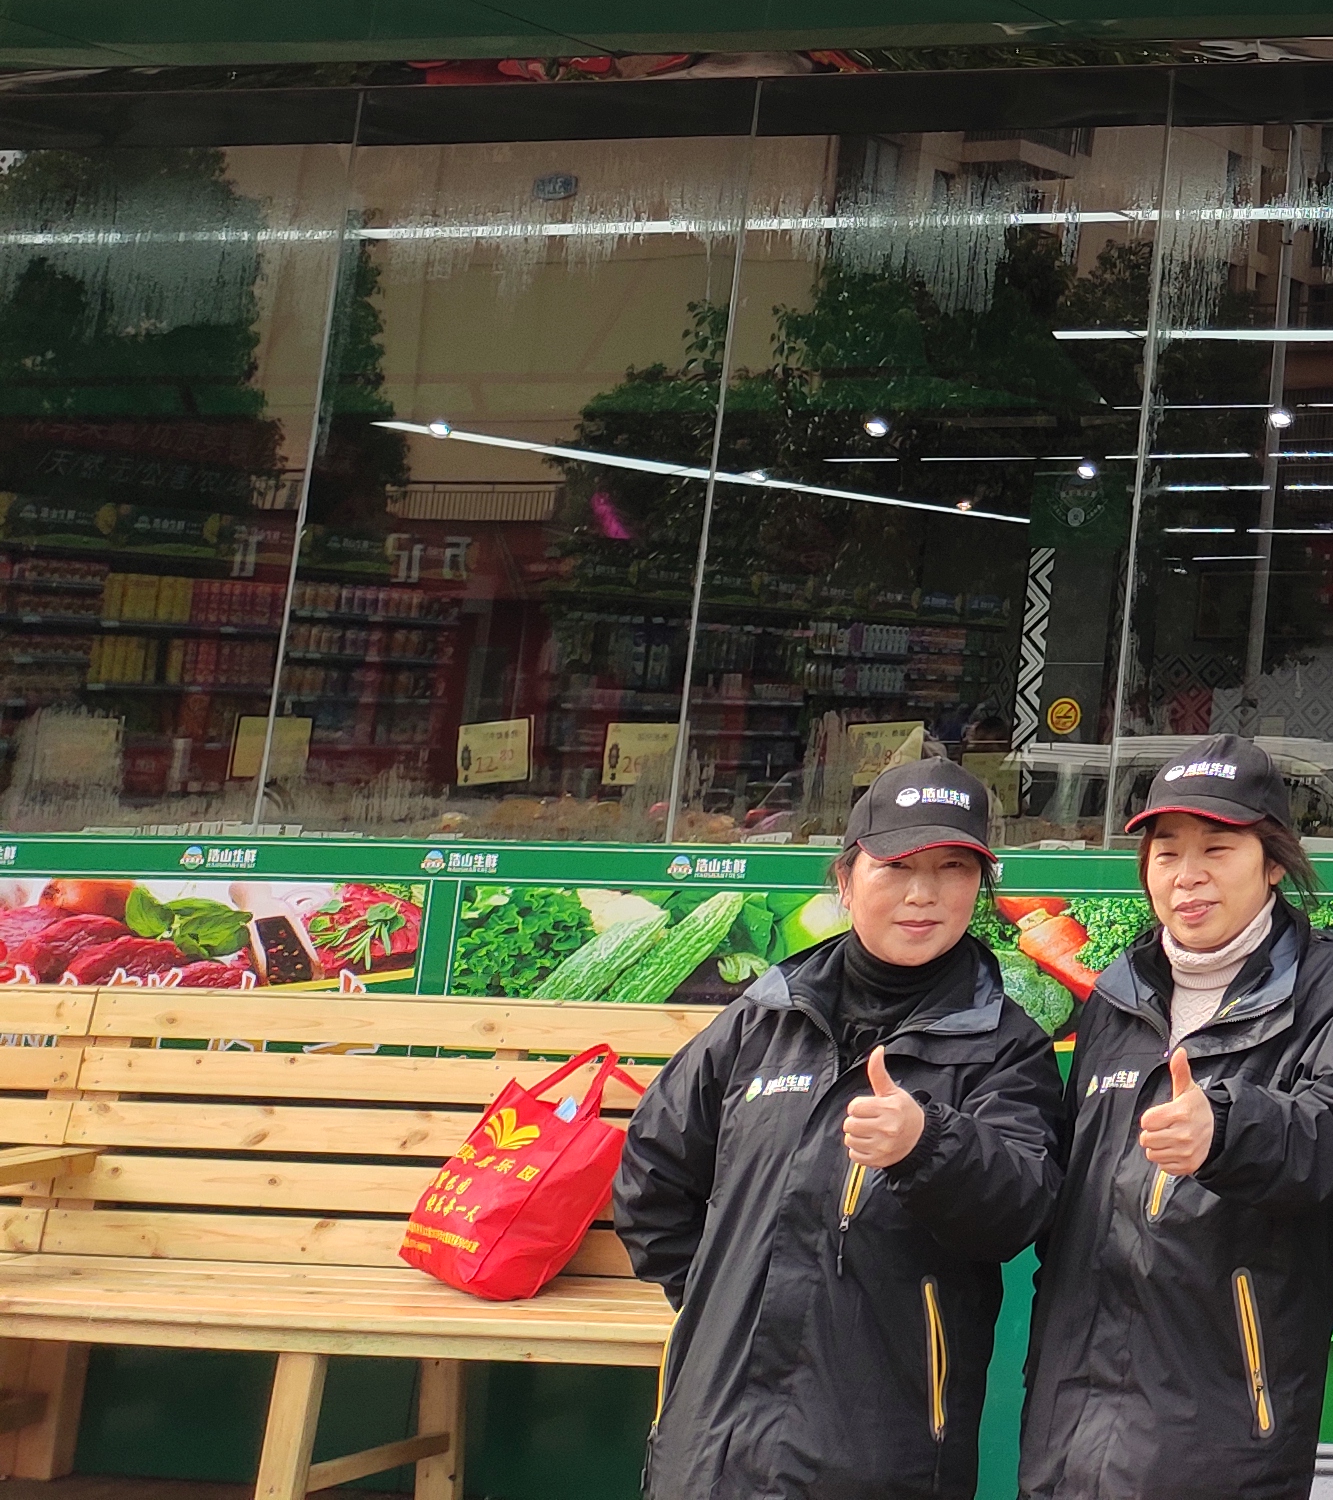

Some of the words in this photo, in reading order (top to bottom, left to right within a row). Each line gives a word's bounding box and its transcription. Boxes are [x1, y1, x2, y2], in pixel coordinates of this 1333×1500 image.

[448, 853, 499, 868] 浩山生鲜
[695, 858, 747, 874] 浩山生鲜
